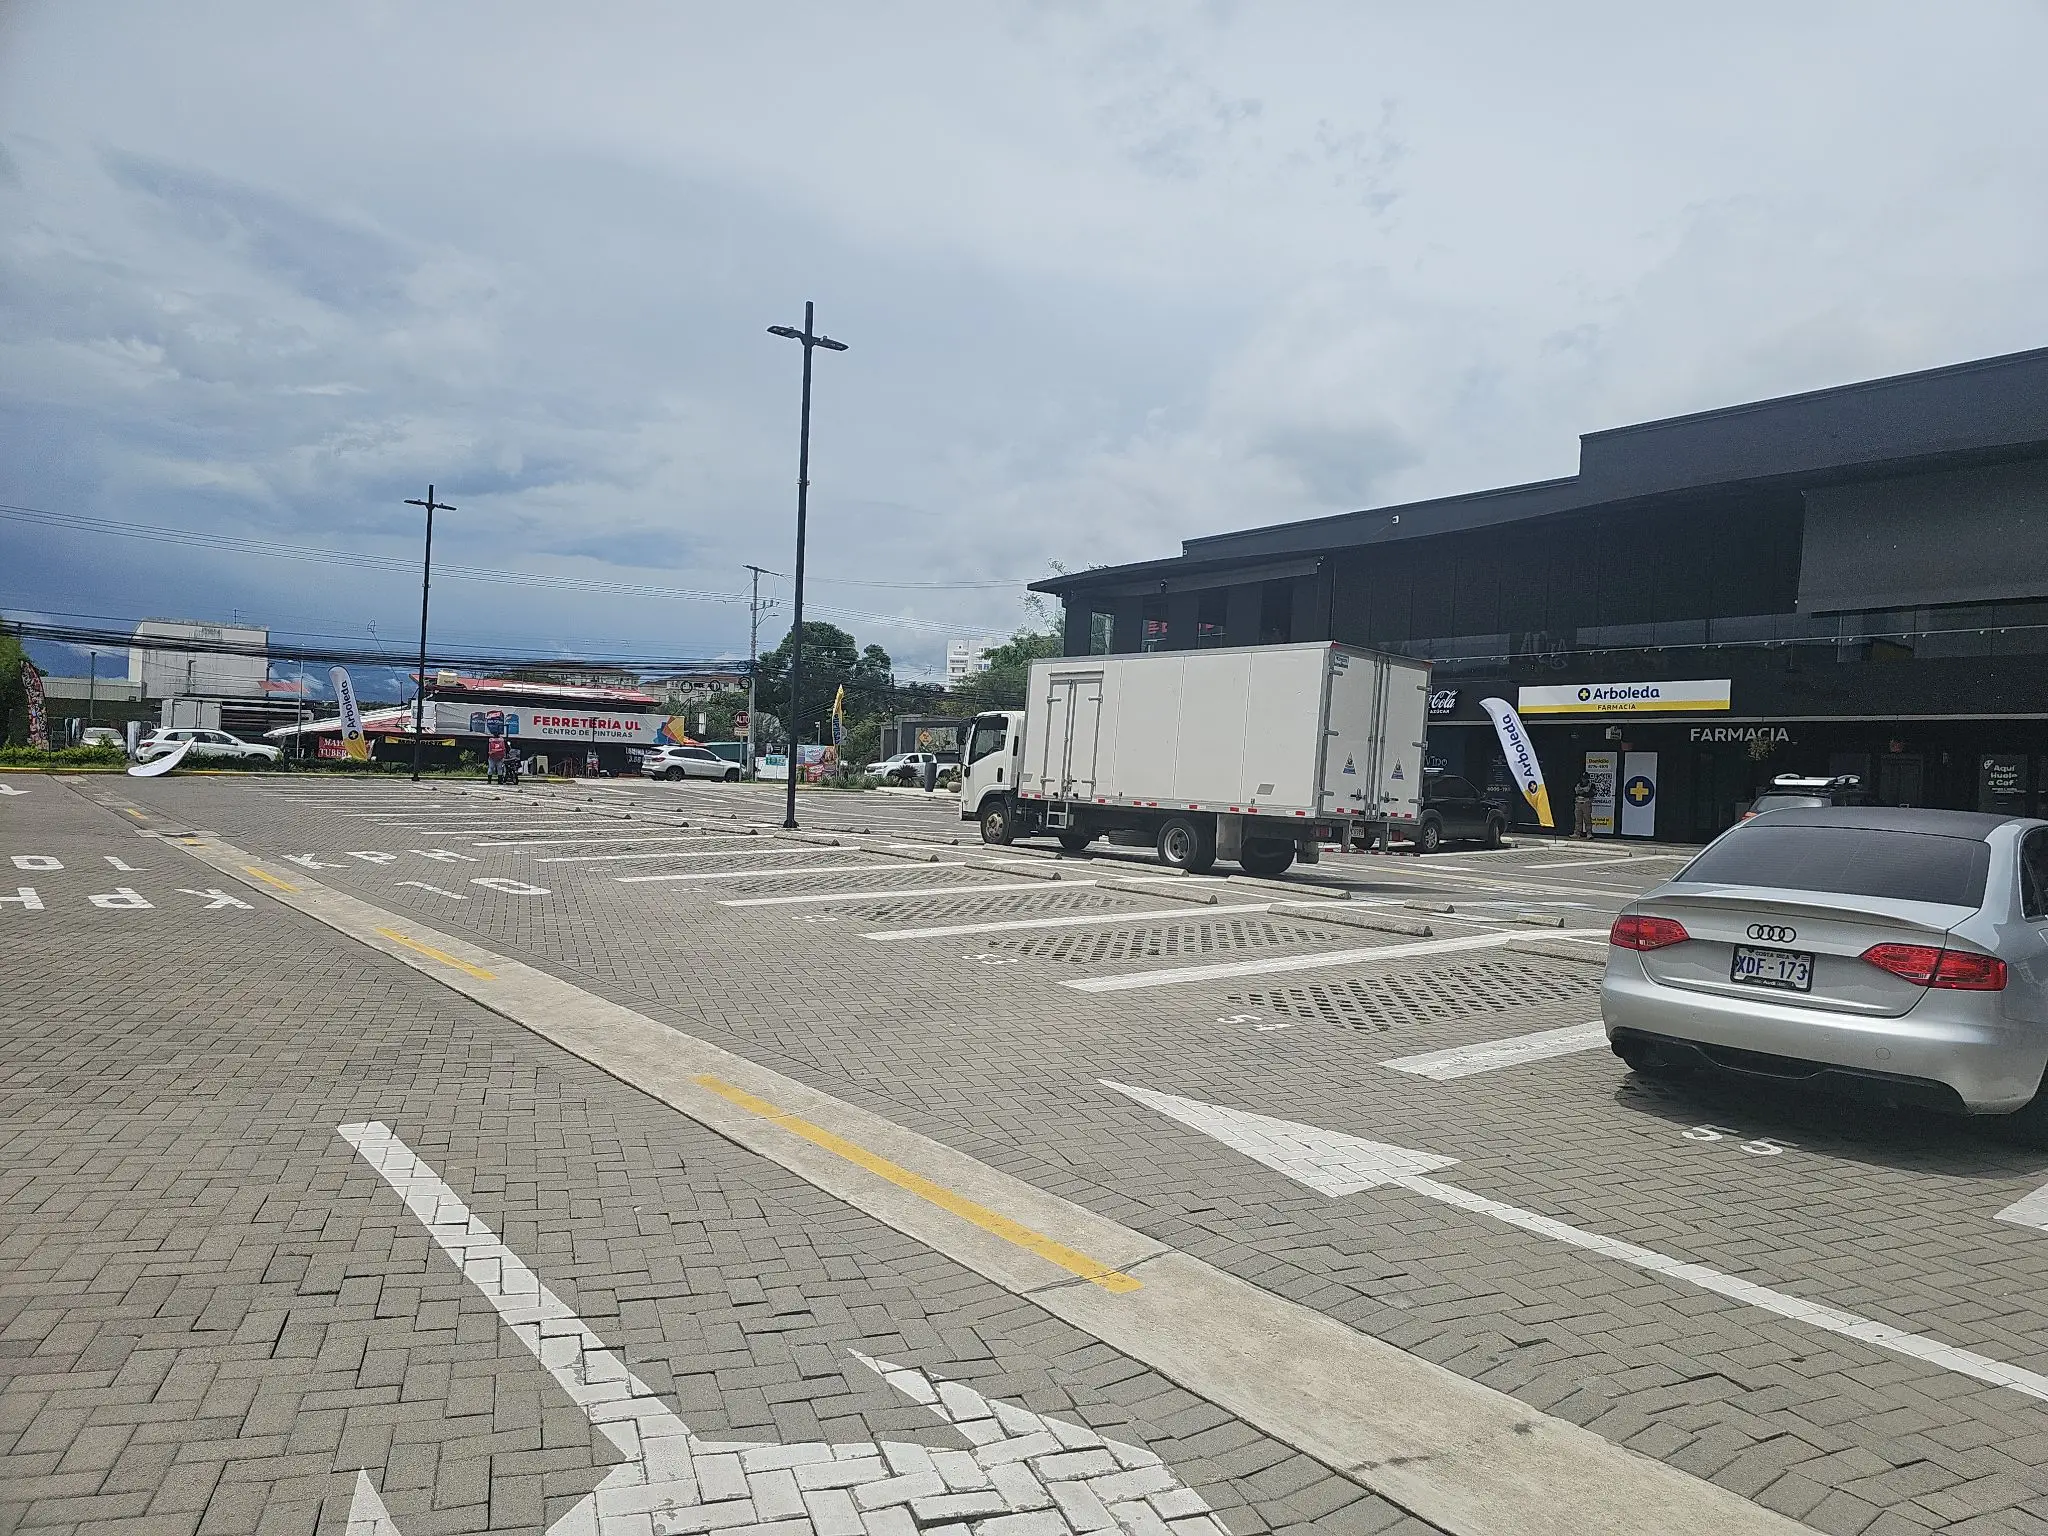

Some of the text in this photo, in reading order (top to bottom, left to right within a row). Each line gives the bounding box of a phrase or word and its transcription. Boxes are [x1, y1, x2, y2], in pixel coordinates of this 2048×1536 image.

[1593, 686, 1660, 700] Arboleda
[341, 680, 356, 728] Arboleda
[533, 715, 621, 730] FERRETERÍA
[625, 721, 642, 730] UL
[736, 715, 750, 724] ALTO
[542, 728, 577, 736] CENTRO
[593, 730, 633, 738] PINTURAS
[1690, 727, 1789, 742] FARMACIA
[1502, 714, 1534, 777] Arboleda
[281, 848, 482, 870] KPH
[394, 877, 552, 899] 10
[1681, 1123, 1800, 1156] 55
